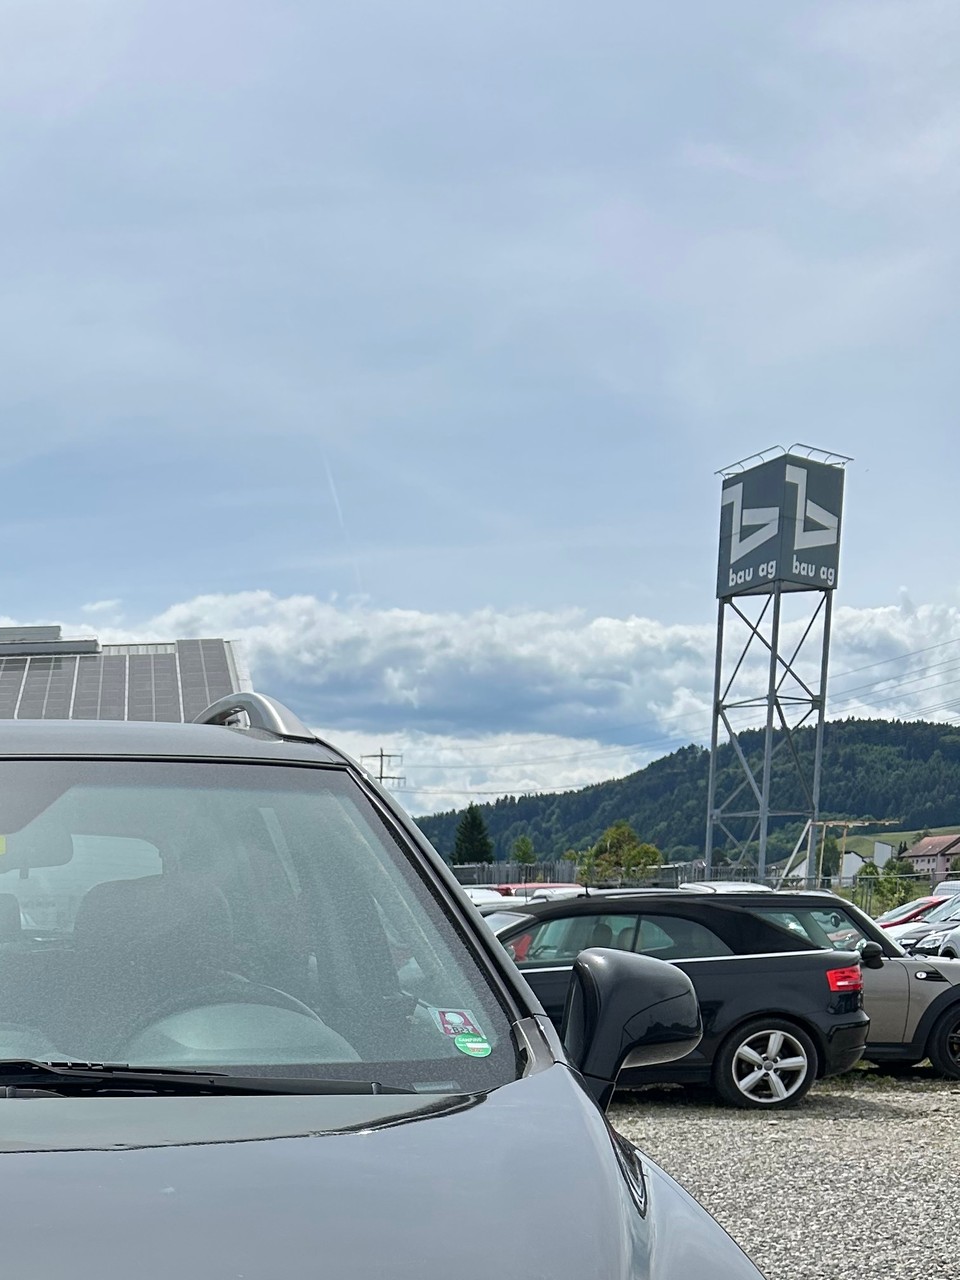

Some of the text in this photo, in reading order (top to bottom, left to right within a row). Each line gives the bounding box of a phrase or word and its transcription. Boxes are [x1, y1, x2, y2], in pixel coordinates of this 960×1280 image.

[729, 560, 777, 587] bau ag
[792, 554, 835, 586] bau ag
